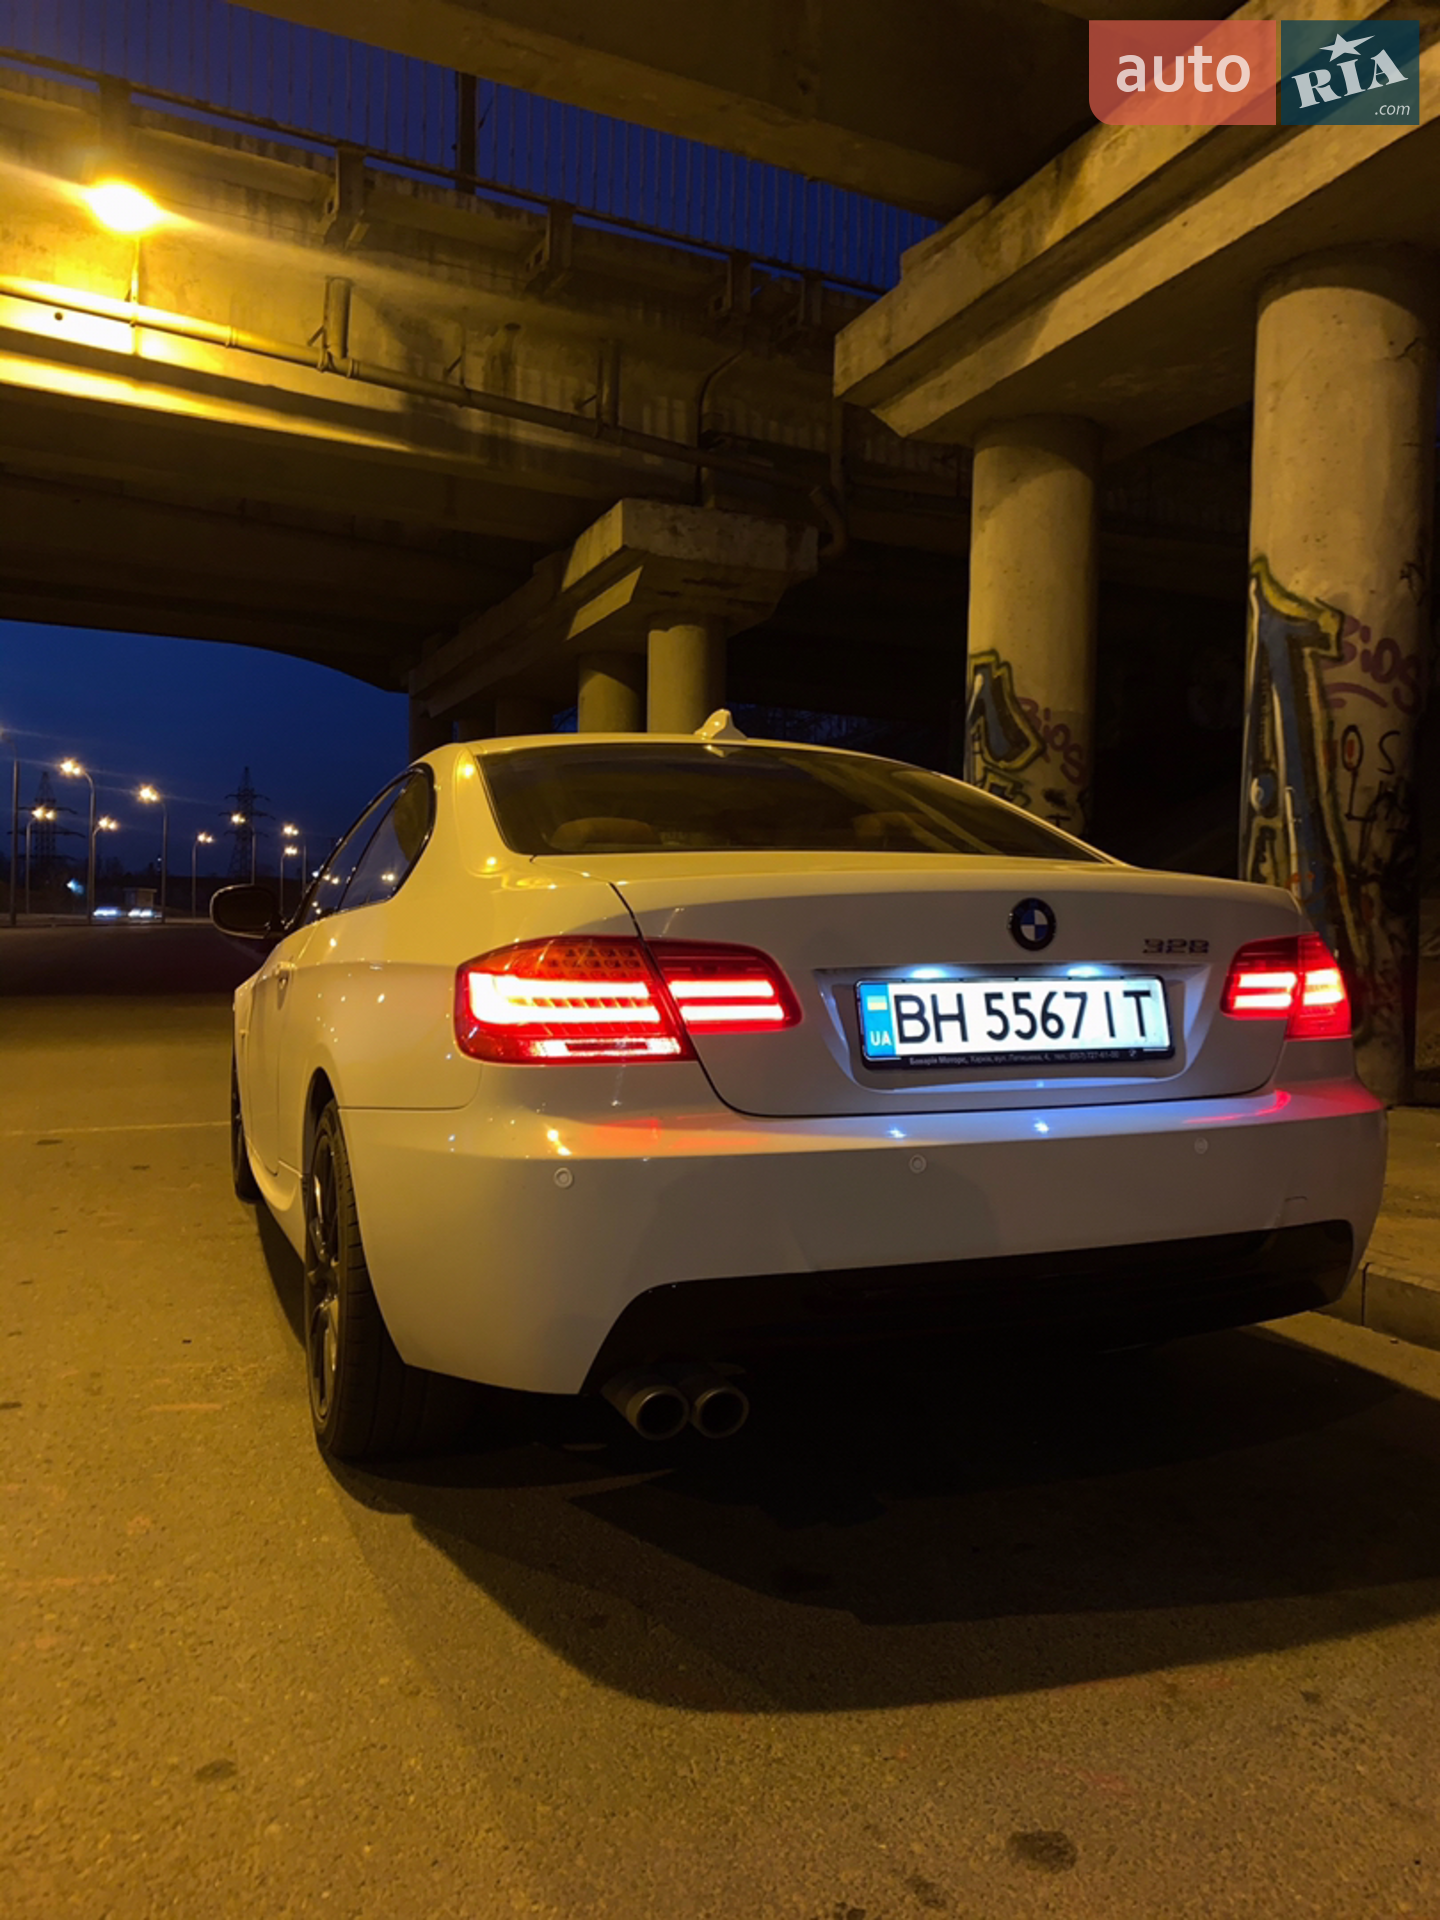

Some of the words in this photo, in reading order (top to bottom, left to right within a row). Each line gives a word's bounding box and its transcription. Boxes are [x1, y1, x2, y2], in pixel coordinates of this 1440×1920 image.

[1142, 938, 1210, 954] 328
[893, 992, 969, 1045] BH
[984, 990, 1088, 1042] 5567
[1103, 989, 1153, 1040] IT
[870, 1029, 893, 1047] UA
